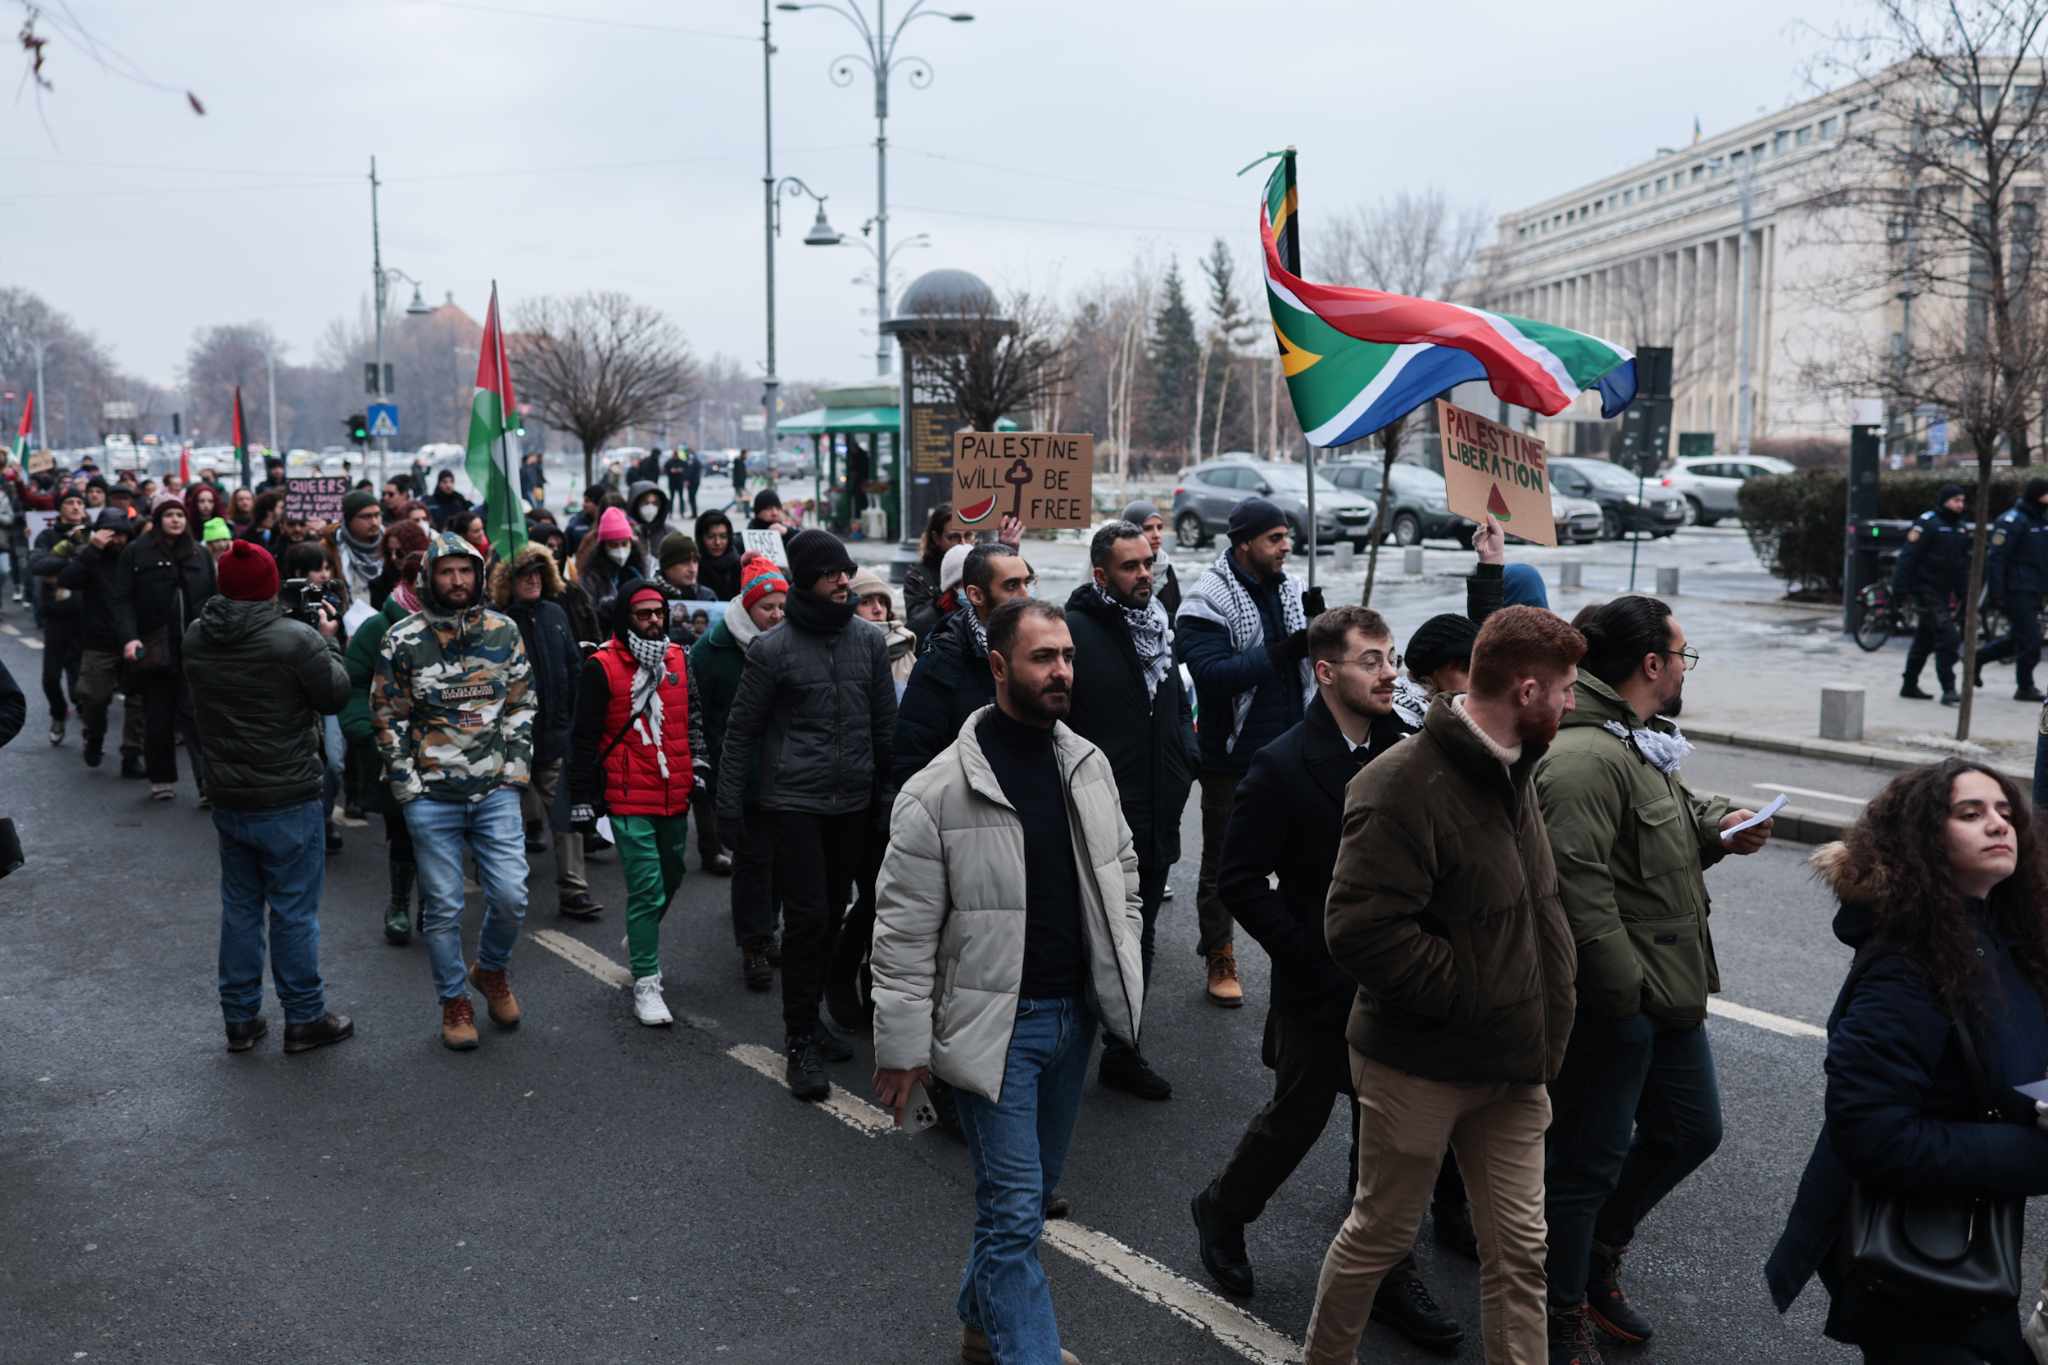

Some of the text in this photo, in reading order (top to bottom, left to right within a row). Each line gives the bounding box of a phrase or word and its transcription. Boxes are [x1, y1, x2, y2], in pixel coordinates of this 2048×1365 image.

[1446, 408, 1544, 470] PALESTINE
[1447, 437, 1544, 494] LIBERATION
[289, 479, 346, 494] QUEERS
[1044, 469, 1070, 490] BE
[1031, 499, 1082, 520] FREE
